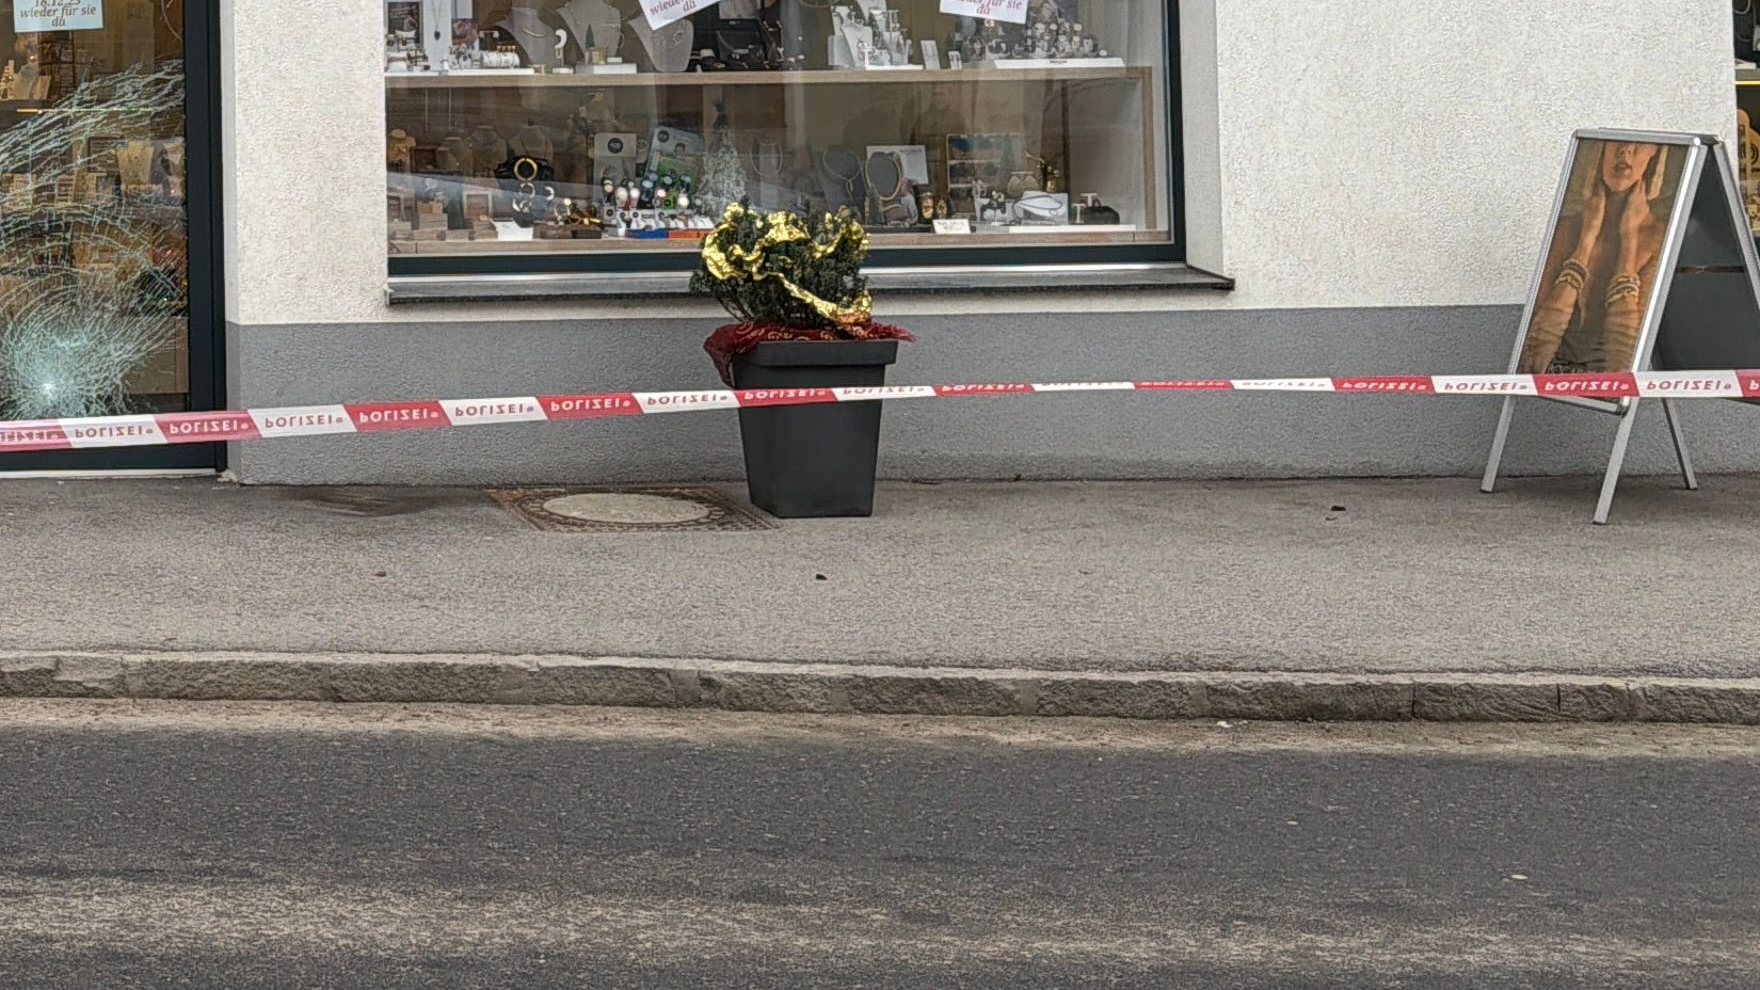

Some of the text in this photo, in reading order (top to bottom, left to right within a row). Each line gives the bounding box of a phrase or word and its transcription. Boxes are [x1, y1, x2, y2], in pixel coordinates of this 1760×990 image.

[683, 0, 696, 11] da
[976, 4, 990, 15] da
[1007, 0, 1022, 10] sie
[20, 8, 59, 18] wieder
[81, 5, 96, 15] sie
[52, 16, 65, 26] da
